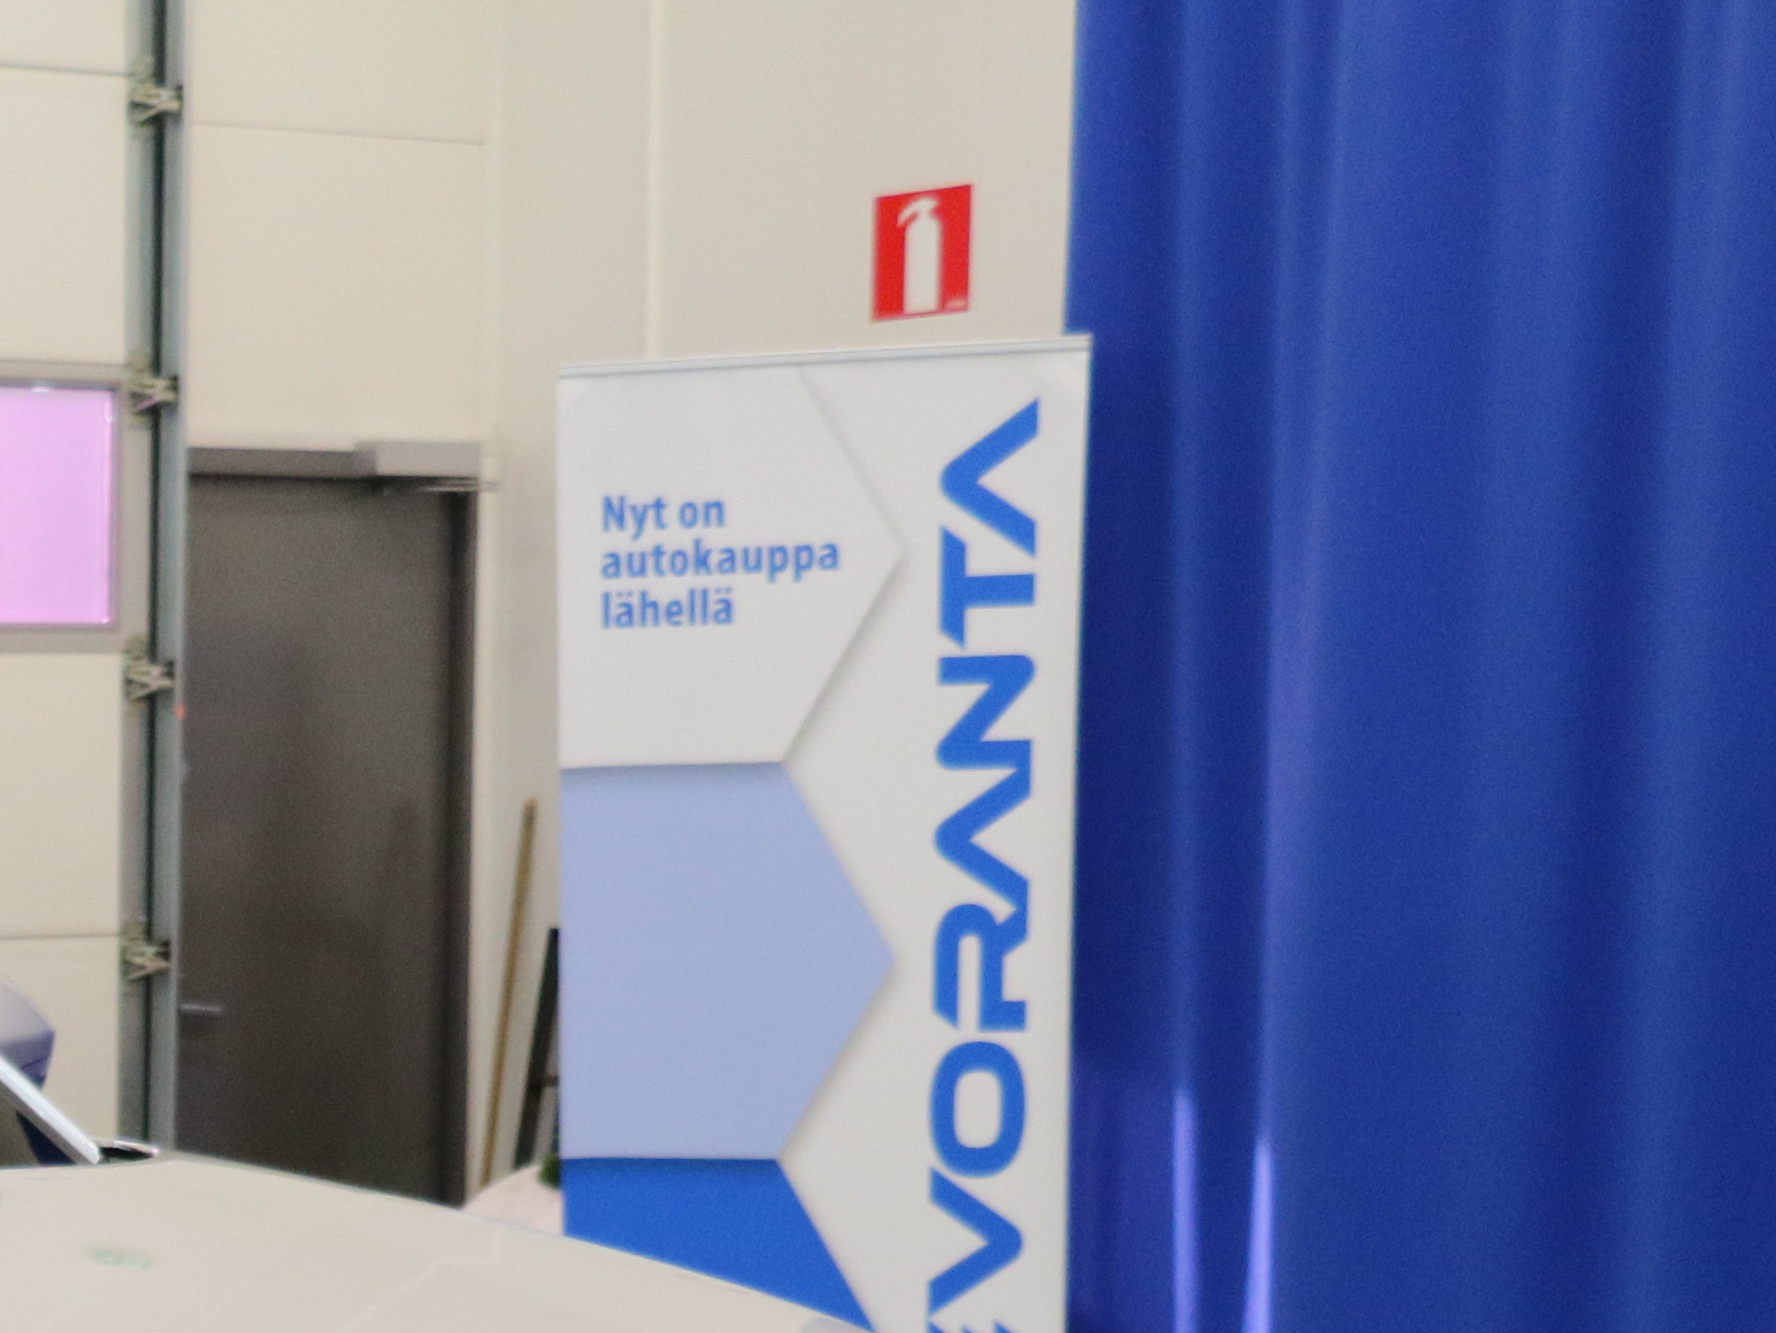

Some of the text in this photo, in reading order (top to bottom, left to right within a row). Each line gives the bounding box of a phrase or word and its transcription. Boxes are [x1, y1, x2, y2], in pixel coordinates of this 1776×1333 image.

[601, 495, 726, 541] Nyt on
[601, 537, 840, 584] autokauppa
[601, 588, 734, 629] lähellä
